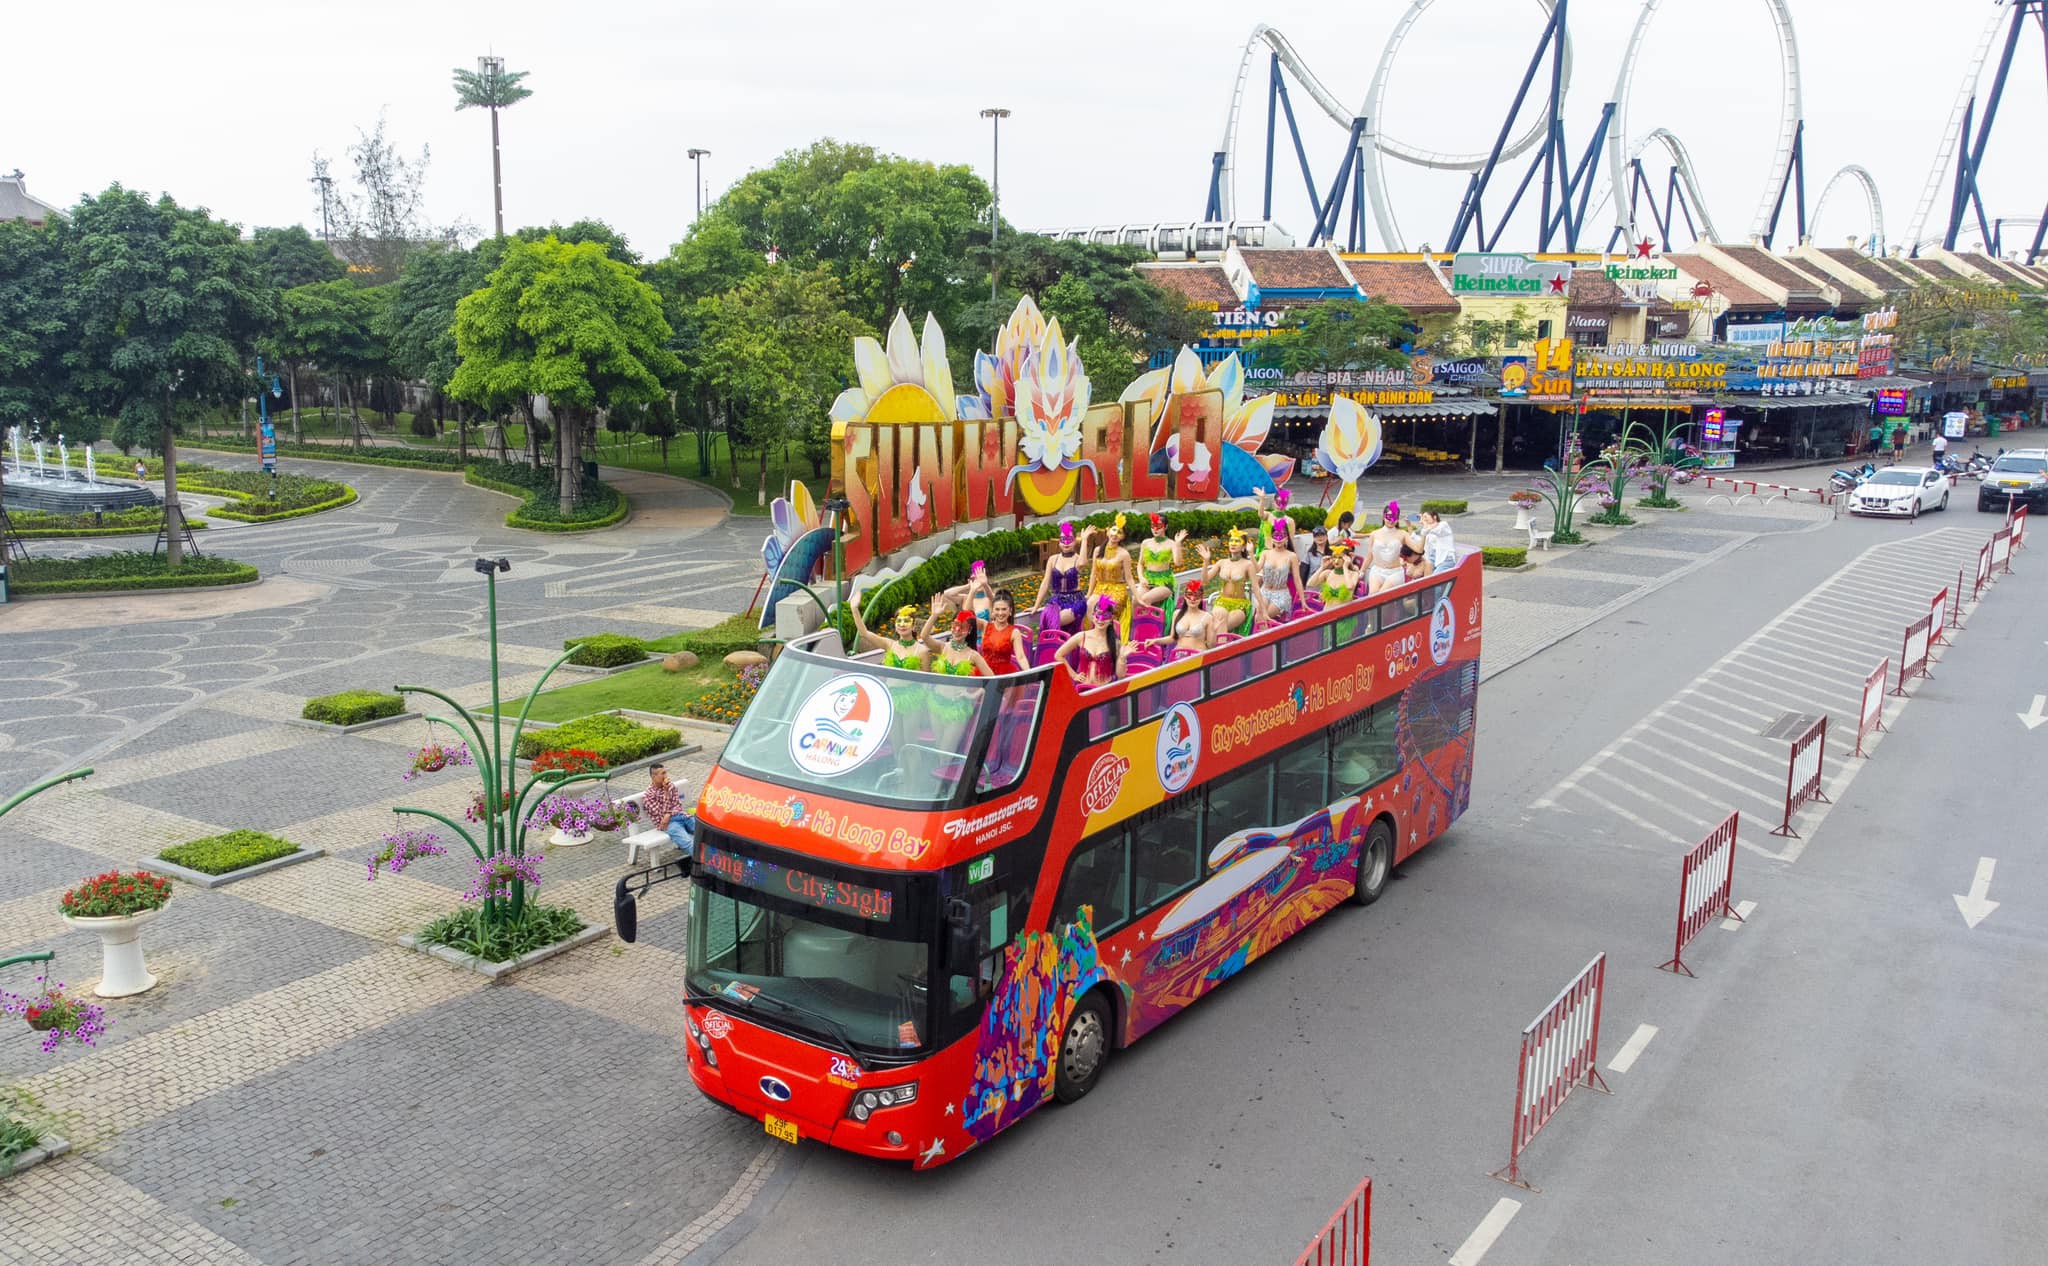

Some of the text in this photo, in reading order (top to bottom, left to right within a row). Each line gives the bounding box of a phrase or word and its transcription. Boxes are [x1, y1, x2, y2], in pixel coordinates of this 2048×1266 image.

[1480, 256, 1524, 274] SILVER
[1605, 264, 1678, 280] Heineken
[1453, 273, 1543, 292] Heineken
[1212, 305, 1261, 325] TIẾN
[1568, 316, 1608, 328] Nana
[1534, 337, 1573, 372] 14
[1638, 344, 1649, 357] &
[1245, 367, 1284, 379] AIGON
[1327, 371, 1352, 385] BIA
[1365, 368, 1405, 385] NHẬU
[1440, 363, 1485, 374] SAIGON
[1575, 358, 1609, 377] HẢI
[1612, 357, 1648, 377] SẢN
[1679, 362, 1726, 378] LONG
[1378, 384, 1407, 404] BÌNH
[1529, 374, 1571, 396] Sun
[841, 420, 954, 577] SUN
[1234, 698, 1297, 746] Sightseeing
[1310, 680, 1325, 713] Ha
[1326, 673, 1353, 707] Long
[1356, 664, 1374, 693] Bay
[1086, 759, 1128, 808] OFFICIAL
[1100, 783, 1120, 808] TOUR
[717, 786, 793, 828] Sightseeing
[811, 808, 836, 837] Ha
[837, 815, 886, 853] Long
[888, 828, 931, 861] Bay
[943, 795, 1039, 840] Vietnamtourism
[975, 828, 998, 845] HANOI
[700, 842, 743, 883] Long
[786, 869, 829, 905] City
